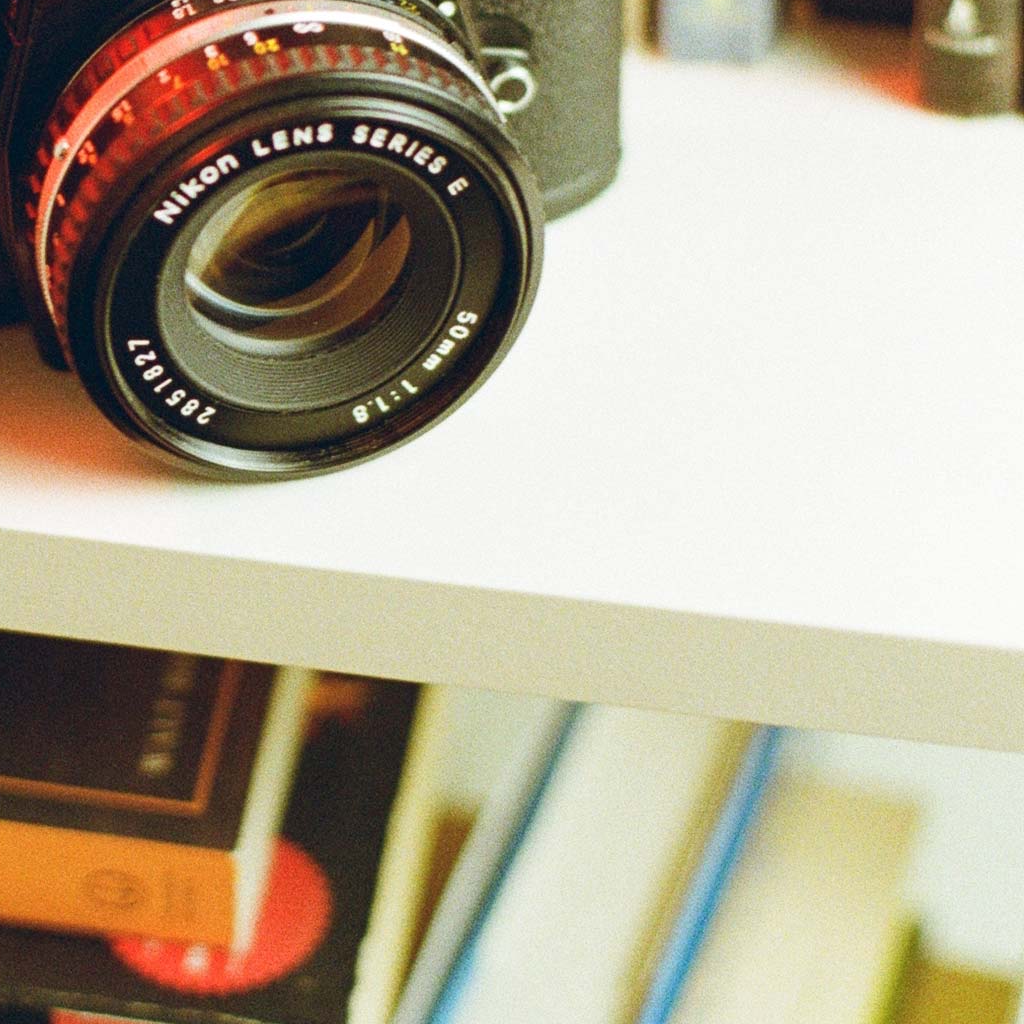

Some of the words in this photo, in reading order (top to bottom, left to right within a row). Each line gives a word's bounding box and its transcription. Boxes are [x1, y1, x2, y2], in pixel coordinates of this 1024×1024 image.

[153, 152, 241, 226] Nikon
[250, 122, 336, 159] LENS
[351, 123, 449, 176] SERIES
[446, 175, 470, 198] E
[125, 337, 218, 426] 2851827
[421, 310, 479, 372] 50mm
